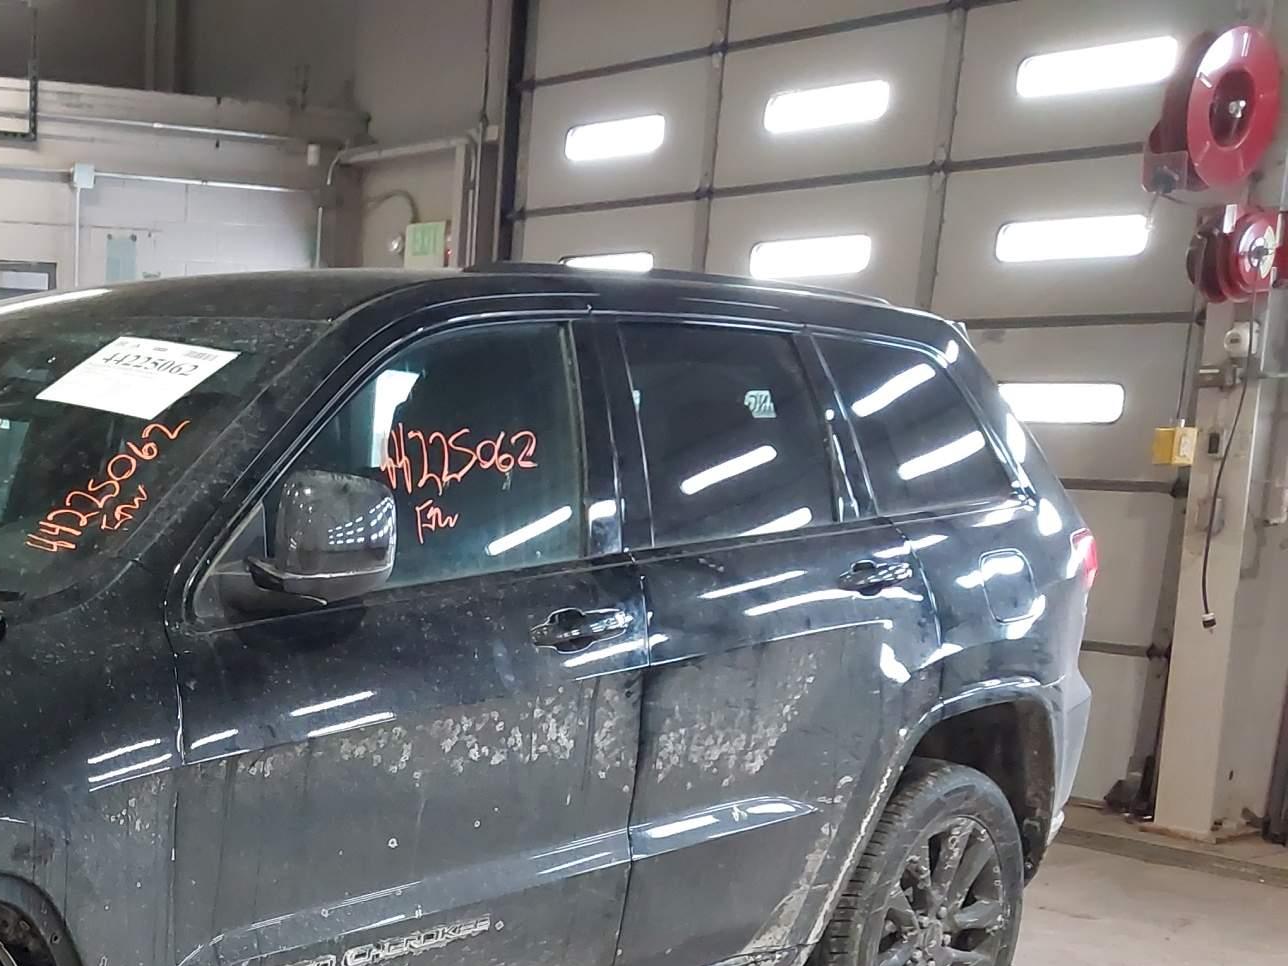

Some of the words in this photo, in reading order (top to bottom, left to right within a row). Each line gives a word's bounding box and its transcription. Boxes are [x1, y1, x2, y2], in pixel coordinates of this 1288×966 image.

[102, 352, 200, 377] 44225062
[25, 418, 191, 552] 44225062
[380, 422, 538, 496] 44225062
